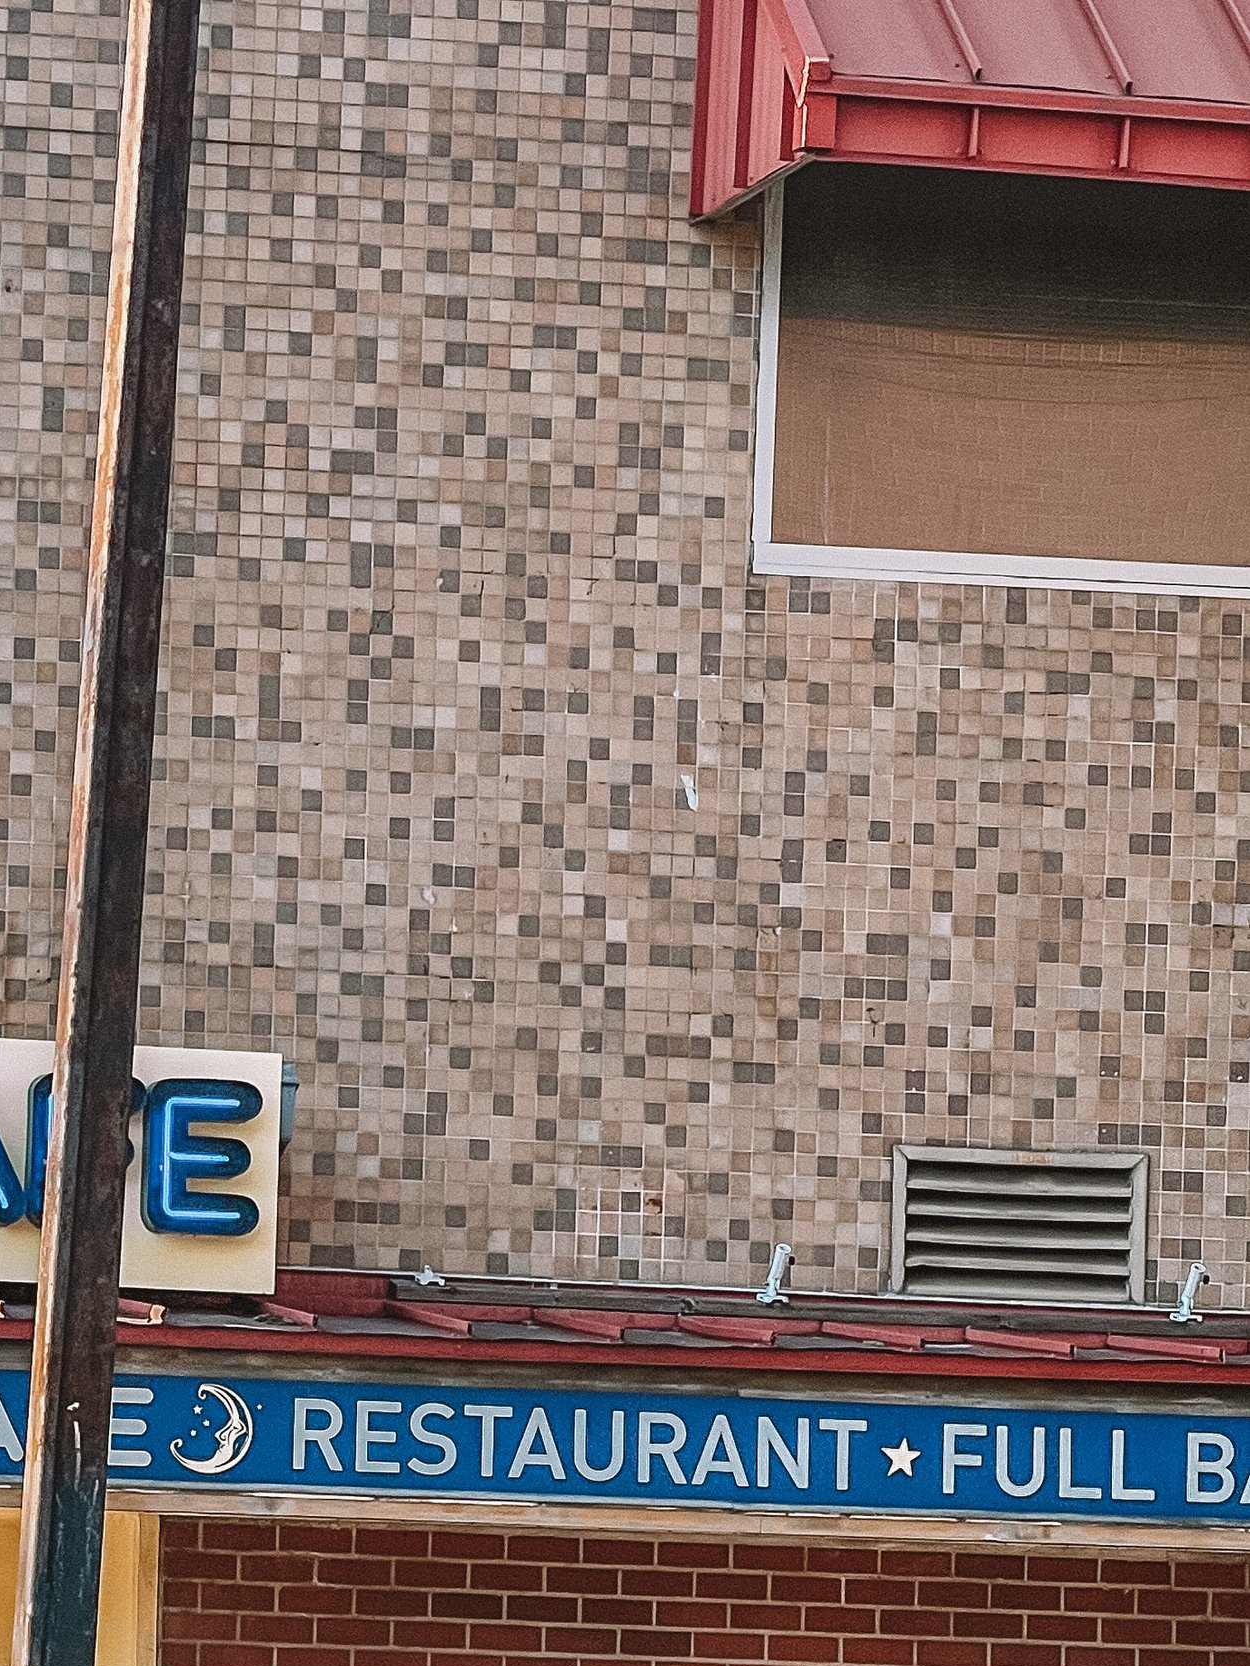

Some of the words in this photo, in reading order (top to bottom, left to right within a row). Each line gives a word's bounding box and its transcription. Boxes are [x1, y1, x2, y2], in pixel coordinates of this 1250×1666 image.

[292, 1397, 868, 1492] RESTAURANT
[943, 1424, 1155, 1502] FULL
[1187, 1432, 1250, 1504] B
